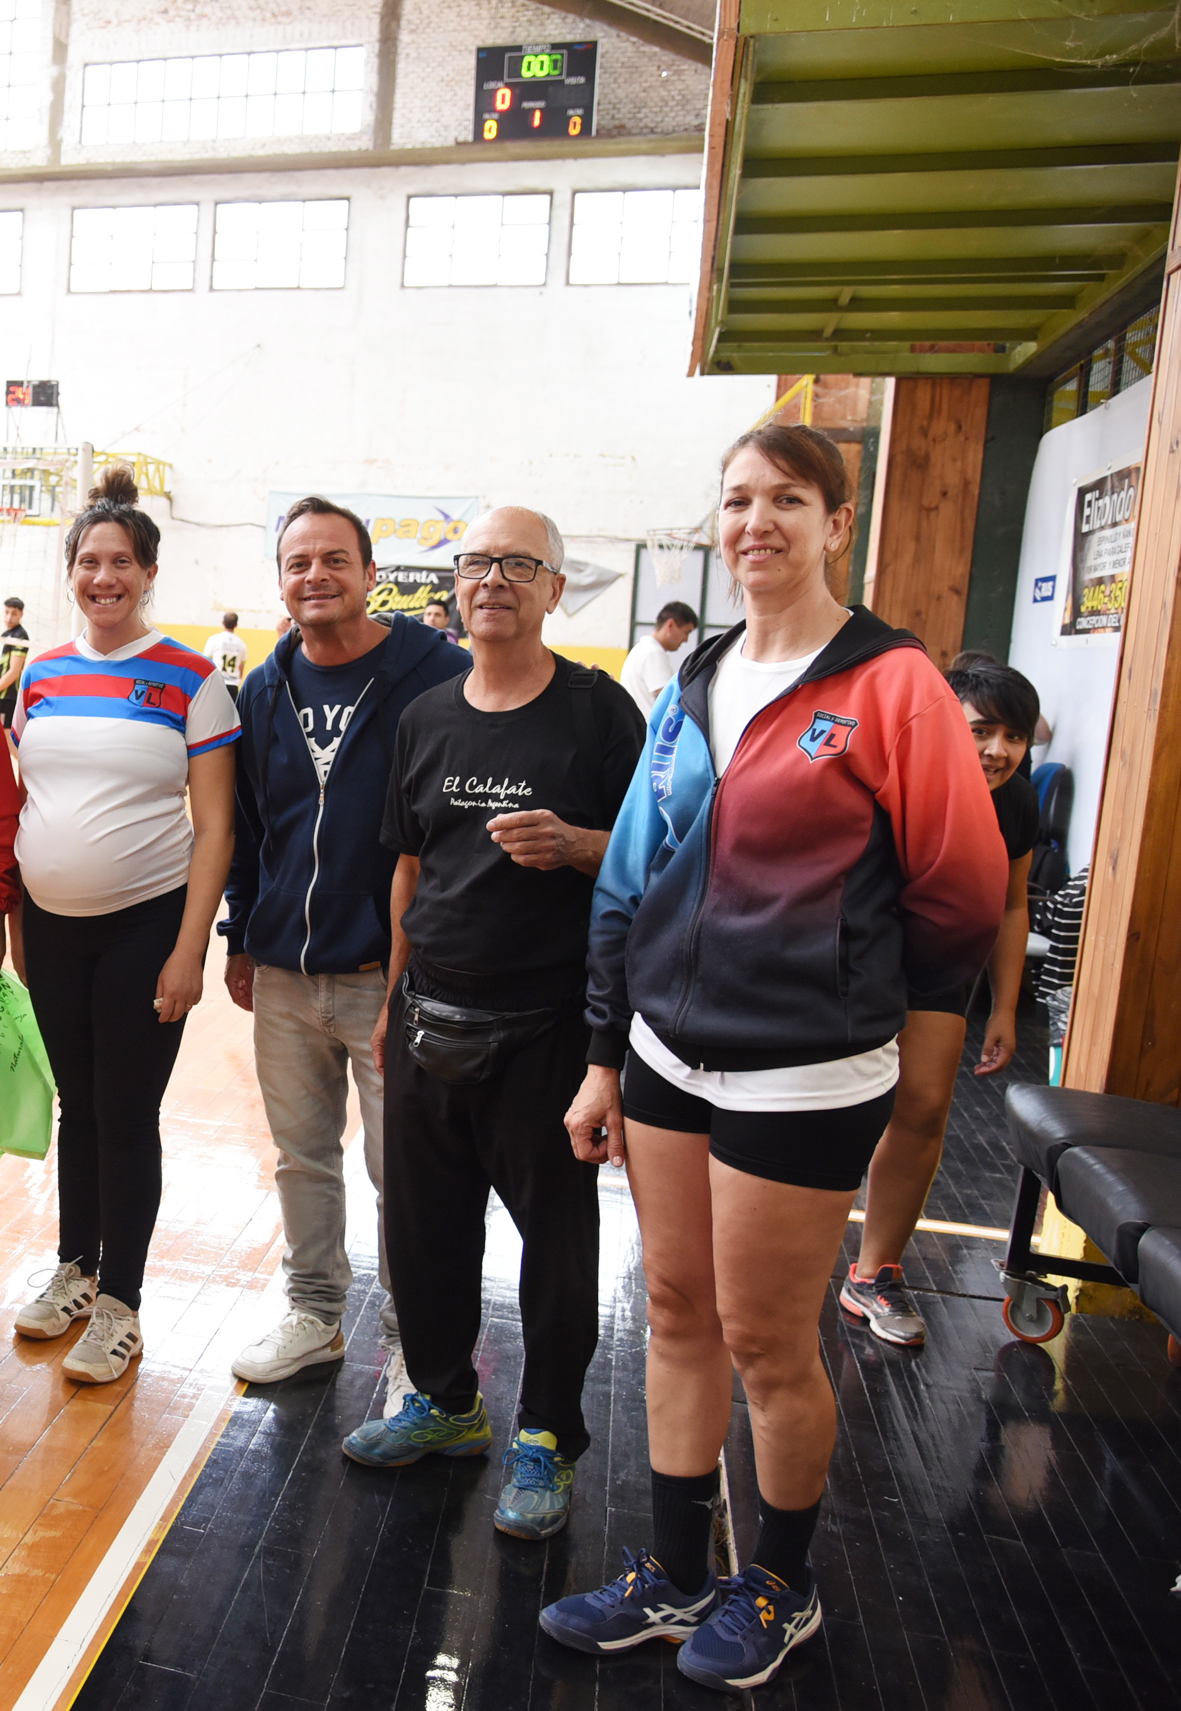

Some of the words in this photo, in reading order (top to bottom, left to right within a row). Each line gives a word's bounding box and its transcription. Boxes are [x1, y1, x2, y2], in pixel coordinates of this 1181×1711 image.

[495, 87, 512, 111] 0
[532, 108, 542, 128] 1
[568, 115, 582, 136] 0
[483, 119, 498, 140] 0
[1081, 478, 1135, 533] Elizondo
[376, 569, 439, 584] OYERÍA
[221, 654, 237, 673] 14
[442, 776, 460, 793] El
[465, 776, 533, 800] Calafate
[450, 797, 487, 809] Patagonia
